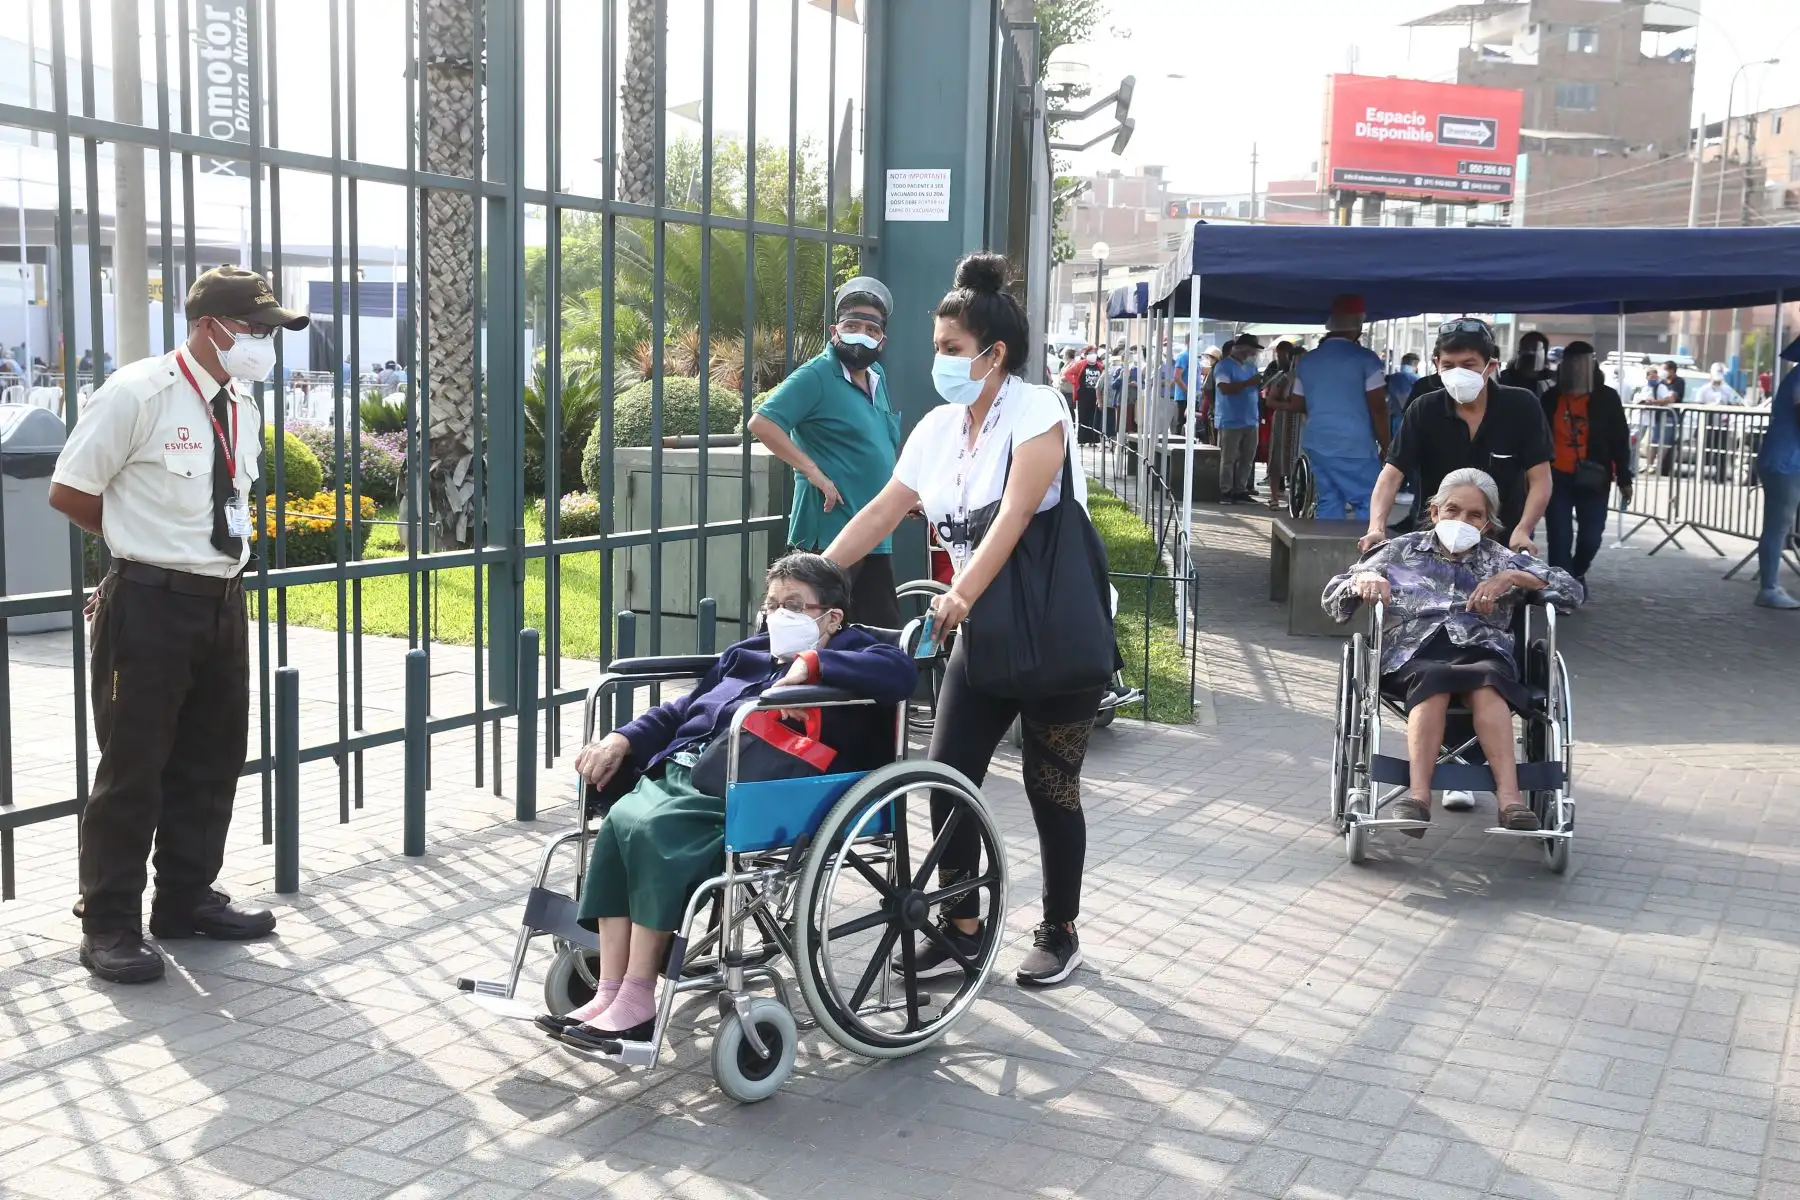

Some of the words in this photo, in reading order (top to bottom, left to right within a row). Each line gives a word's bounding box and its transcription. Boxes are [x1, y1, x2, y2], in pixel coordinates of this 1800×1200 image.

[233, 6, 249, 67] Norte
[235, 73, 250, 132] Plaza
[1366, 106, 1426, 125] Espacio
[1355, 122, 1434, 142] Disponible
[164, 442, 203, 450] ESVICSAC
